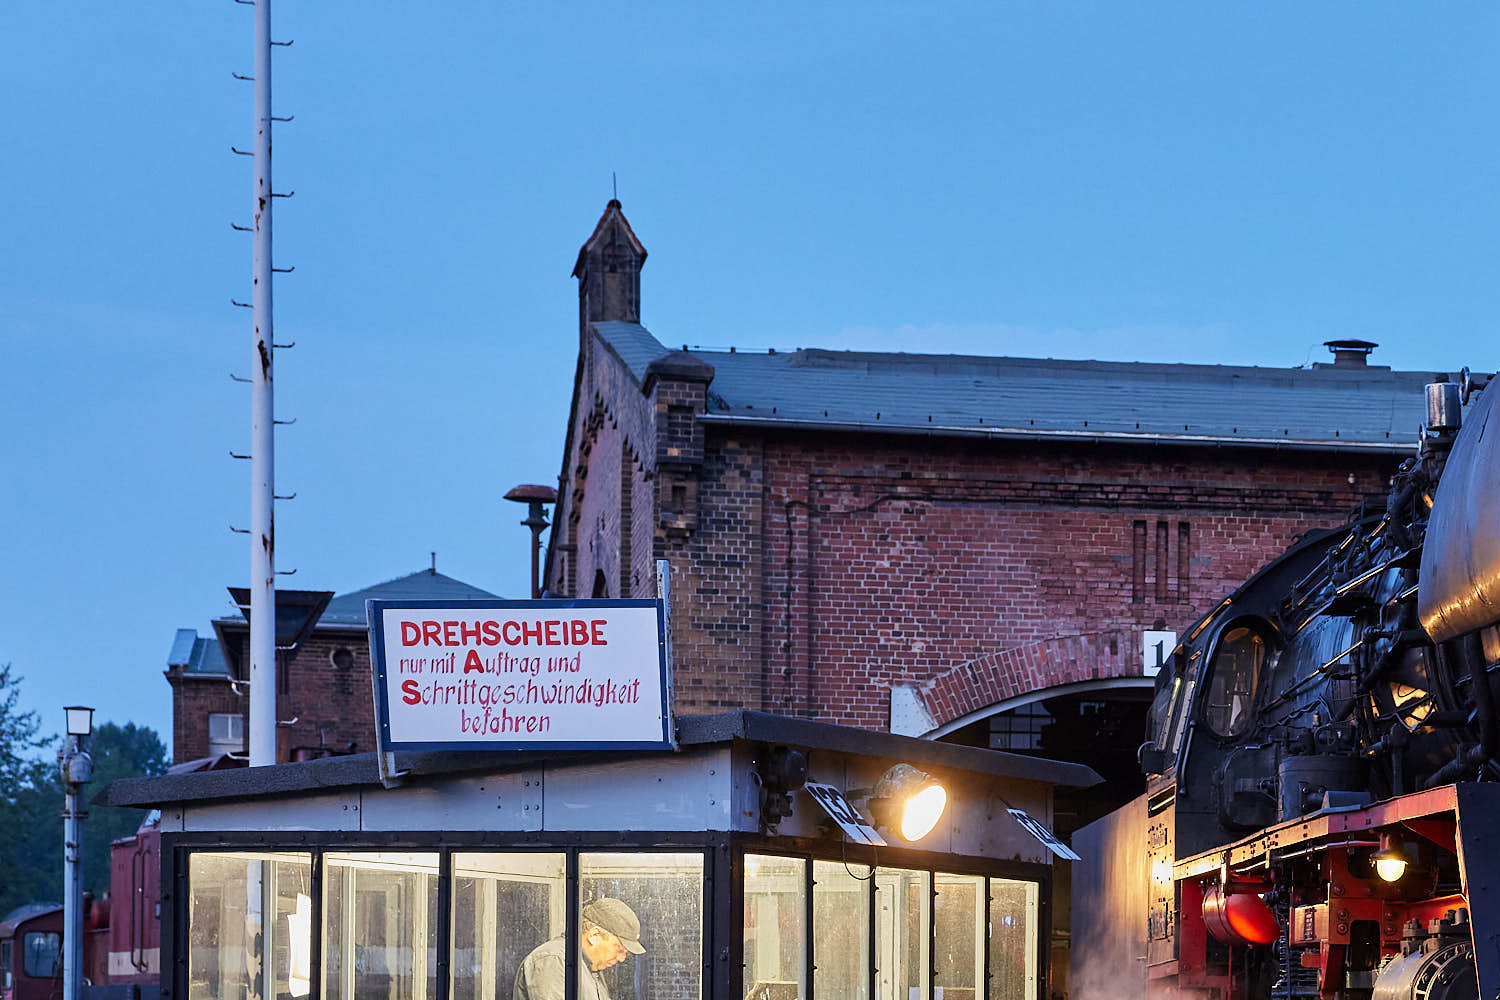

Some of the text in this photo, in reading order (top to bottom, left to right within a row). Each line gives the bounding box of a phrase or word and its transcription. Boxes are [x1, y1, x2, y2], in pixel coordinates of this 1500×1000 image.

[400, 620, 608, 647] DREHSCHEIBE
[399, 649, 582, 677] nur mit Auftrag und
[1151, 639, 1164, 668] 1
[400, 678, 641, 709] Schrittgeschwindigkeit
[460, 706, 550, 736] befahren
